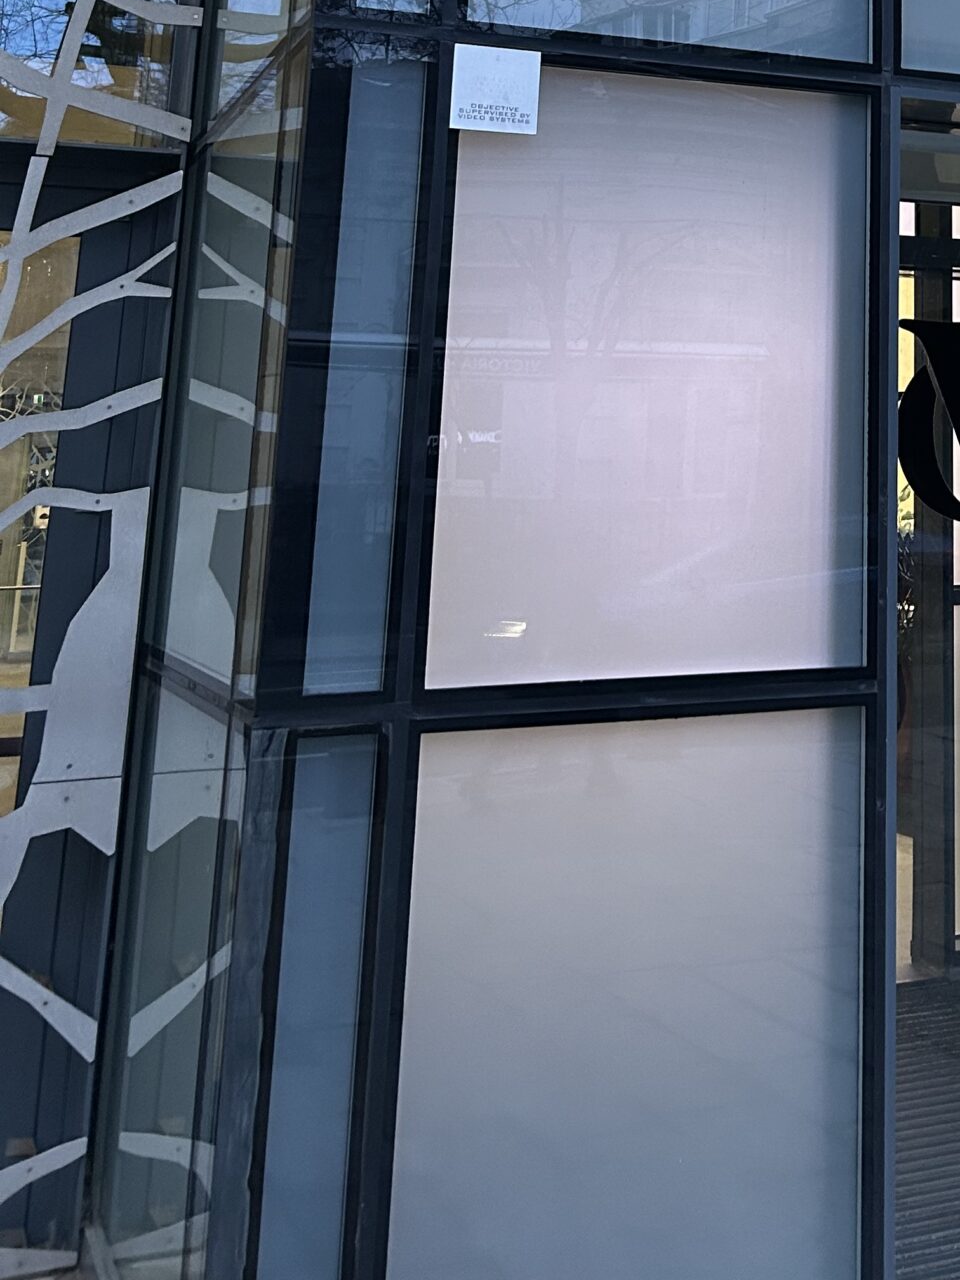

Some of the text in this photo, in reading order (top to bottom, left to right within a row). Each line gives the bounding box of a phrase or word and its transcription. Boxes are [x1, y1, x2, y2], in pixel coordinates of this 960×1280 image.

[470, 103, 519, 112] OBJECTIVE
[458, 108, 517, 118] SUPERVISED
[457, 113, 531, 125] VIDEO SYSTEMS
